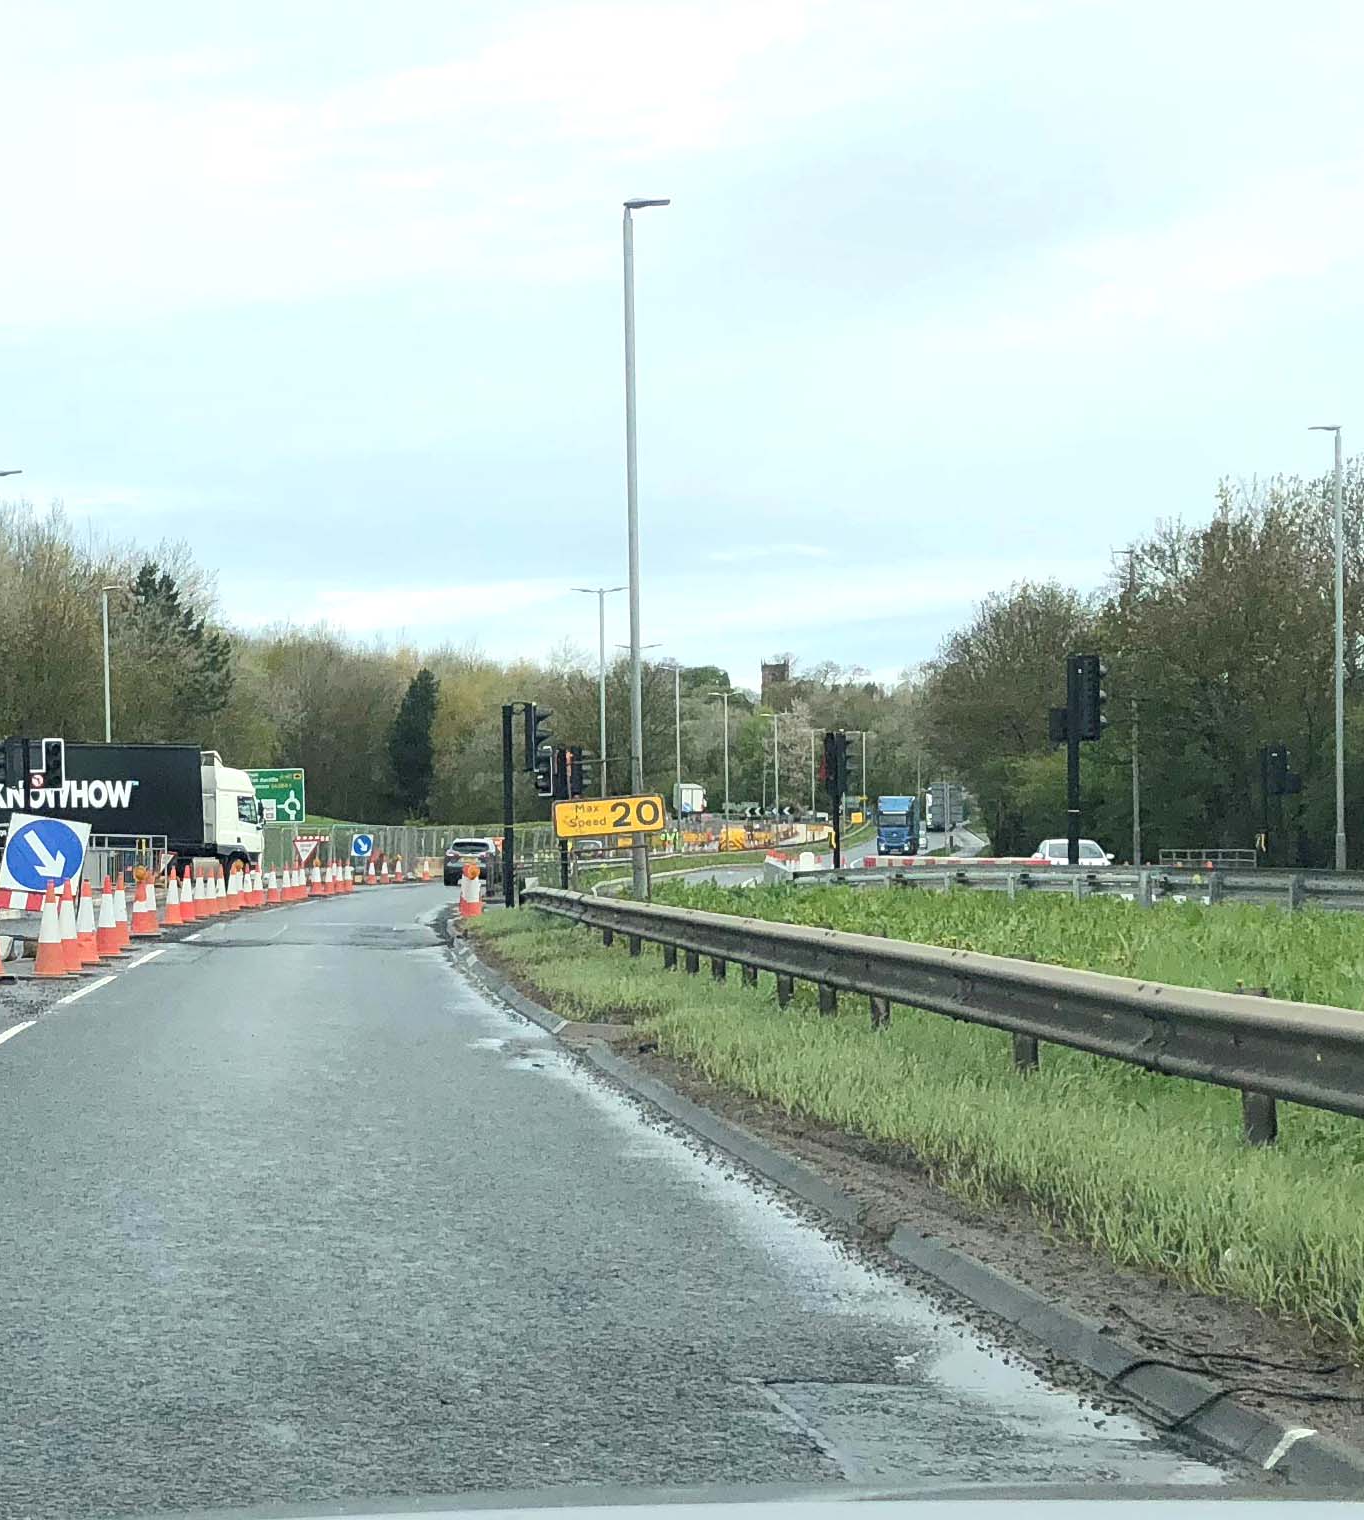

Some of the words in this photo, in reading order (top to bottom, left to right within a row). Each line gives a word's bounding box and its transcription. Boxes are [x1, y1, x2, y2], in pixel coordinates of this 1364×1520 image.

[575, 804, 599, 813] Max
[610, 799, 660, 828] 20
[568, 816, 607, 828] Speed
